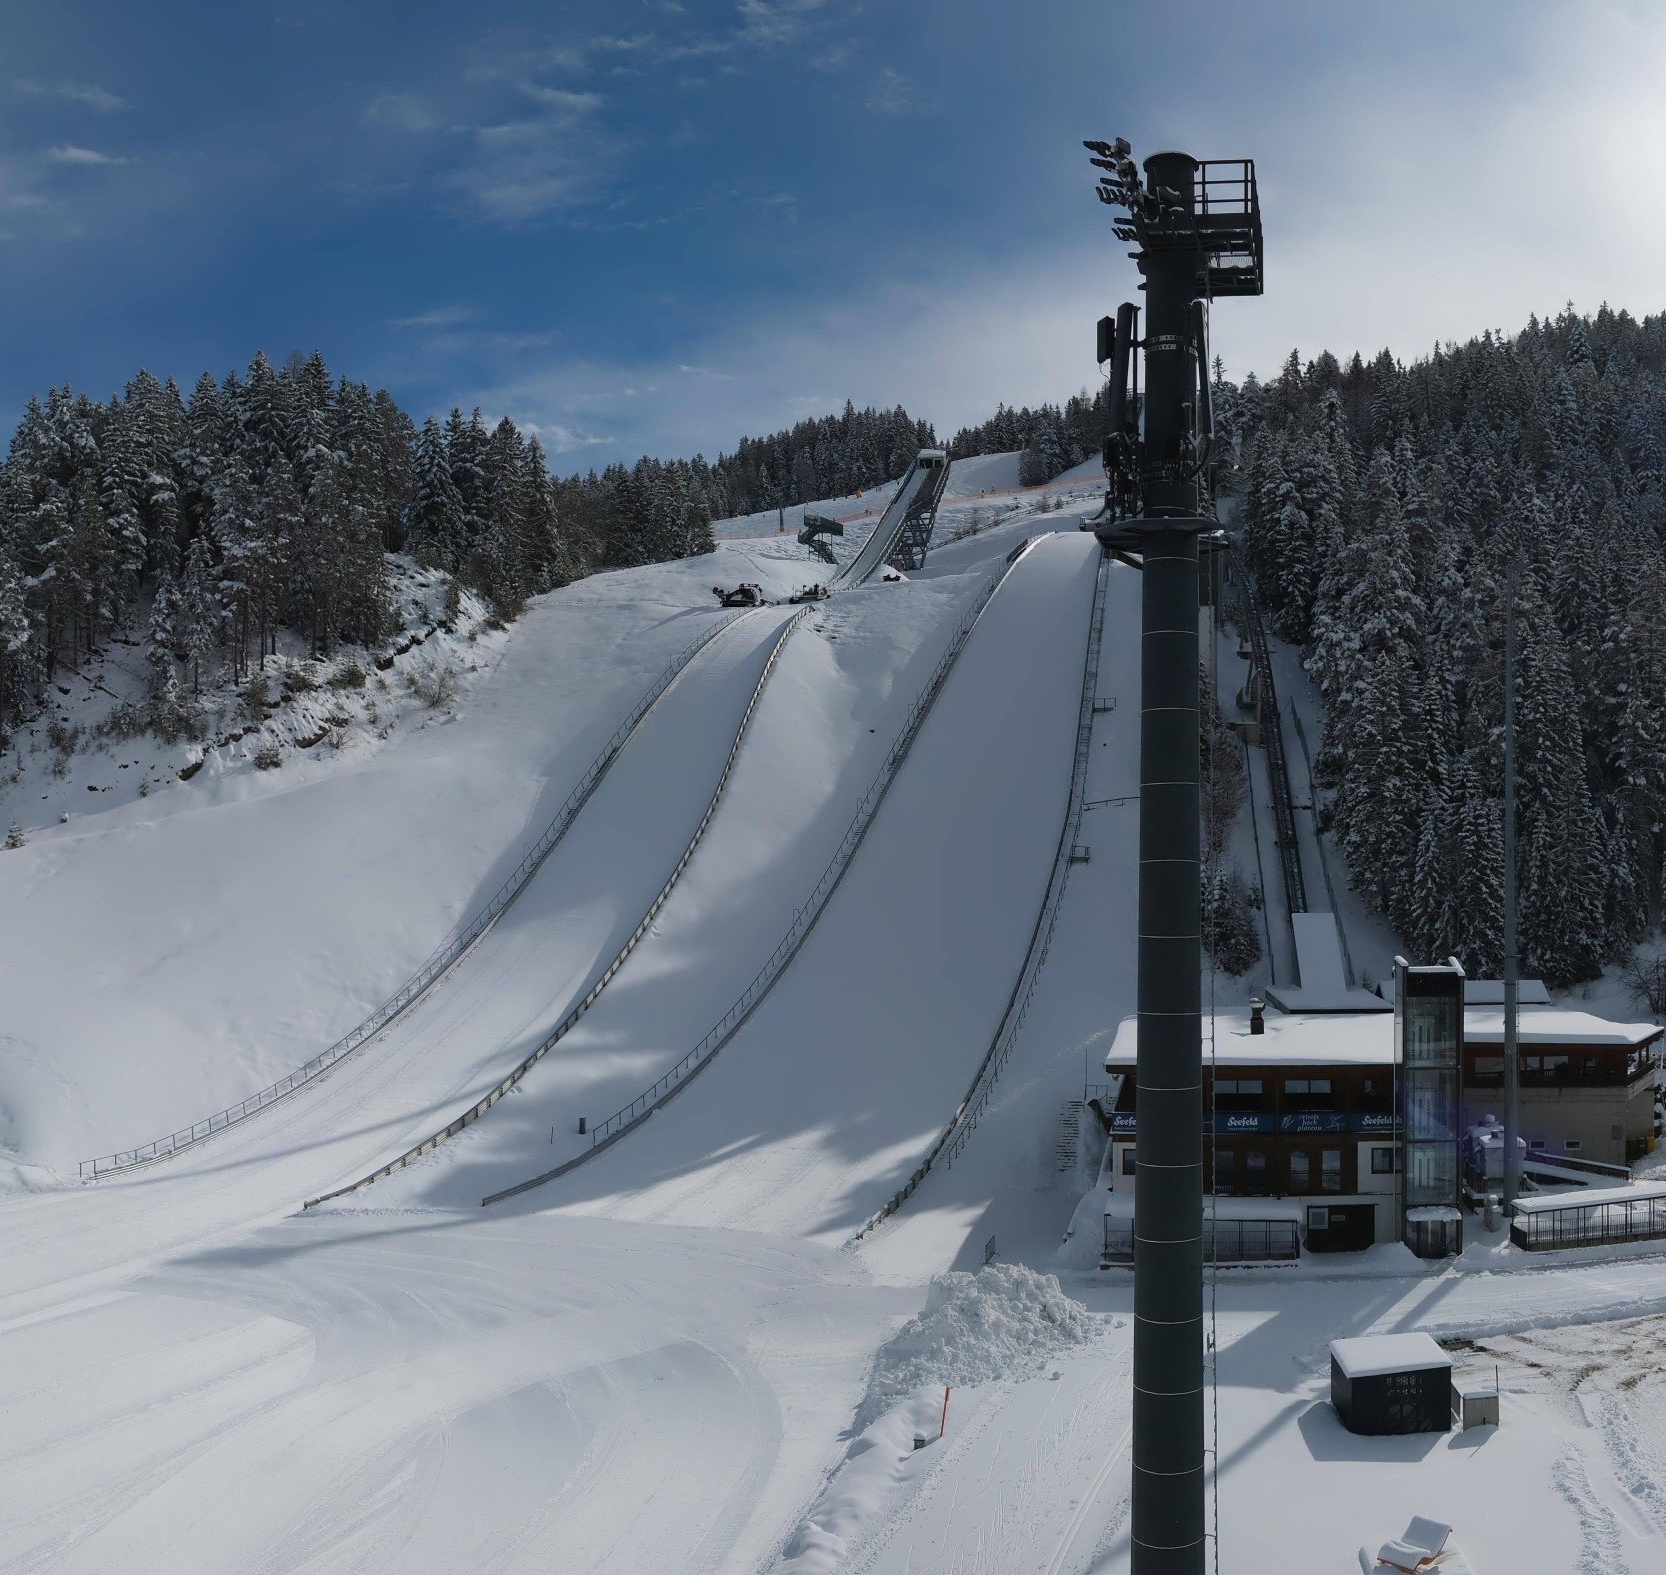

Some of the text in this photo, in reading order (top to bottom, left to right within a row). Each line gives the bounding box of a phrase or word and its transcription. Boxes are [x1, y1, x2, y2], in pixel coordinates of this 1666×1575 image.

[1114, 1115, 1136, 1126] Seefe
[1227, 1116, 1258, 1127] Seefeld
[1302, 1118, 1317, 1126] hoch
[1362, 1115, 1393, 1126] Seefeld
